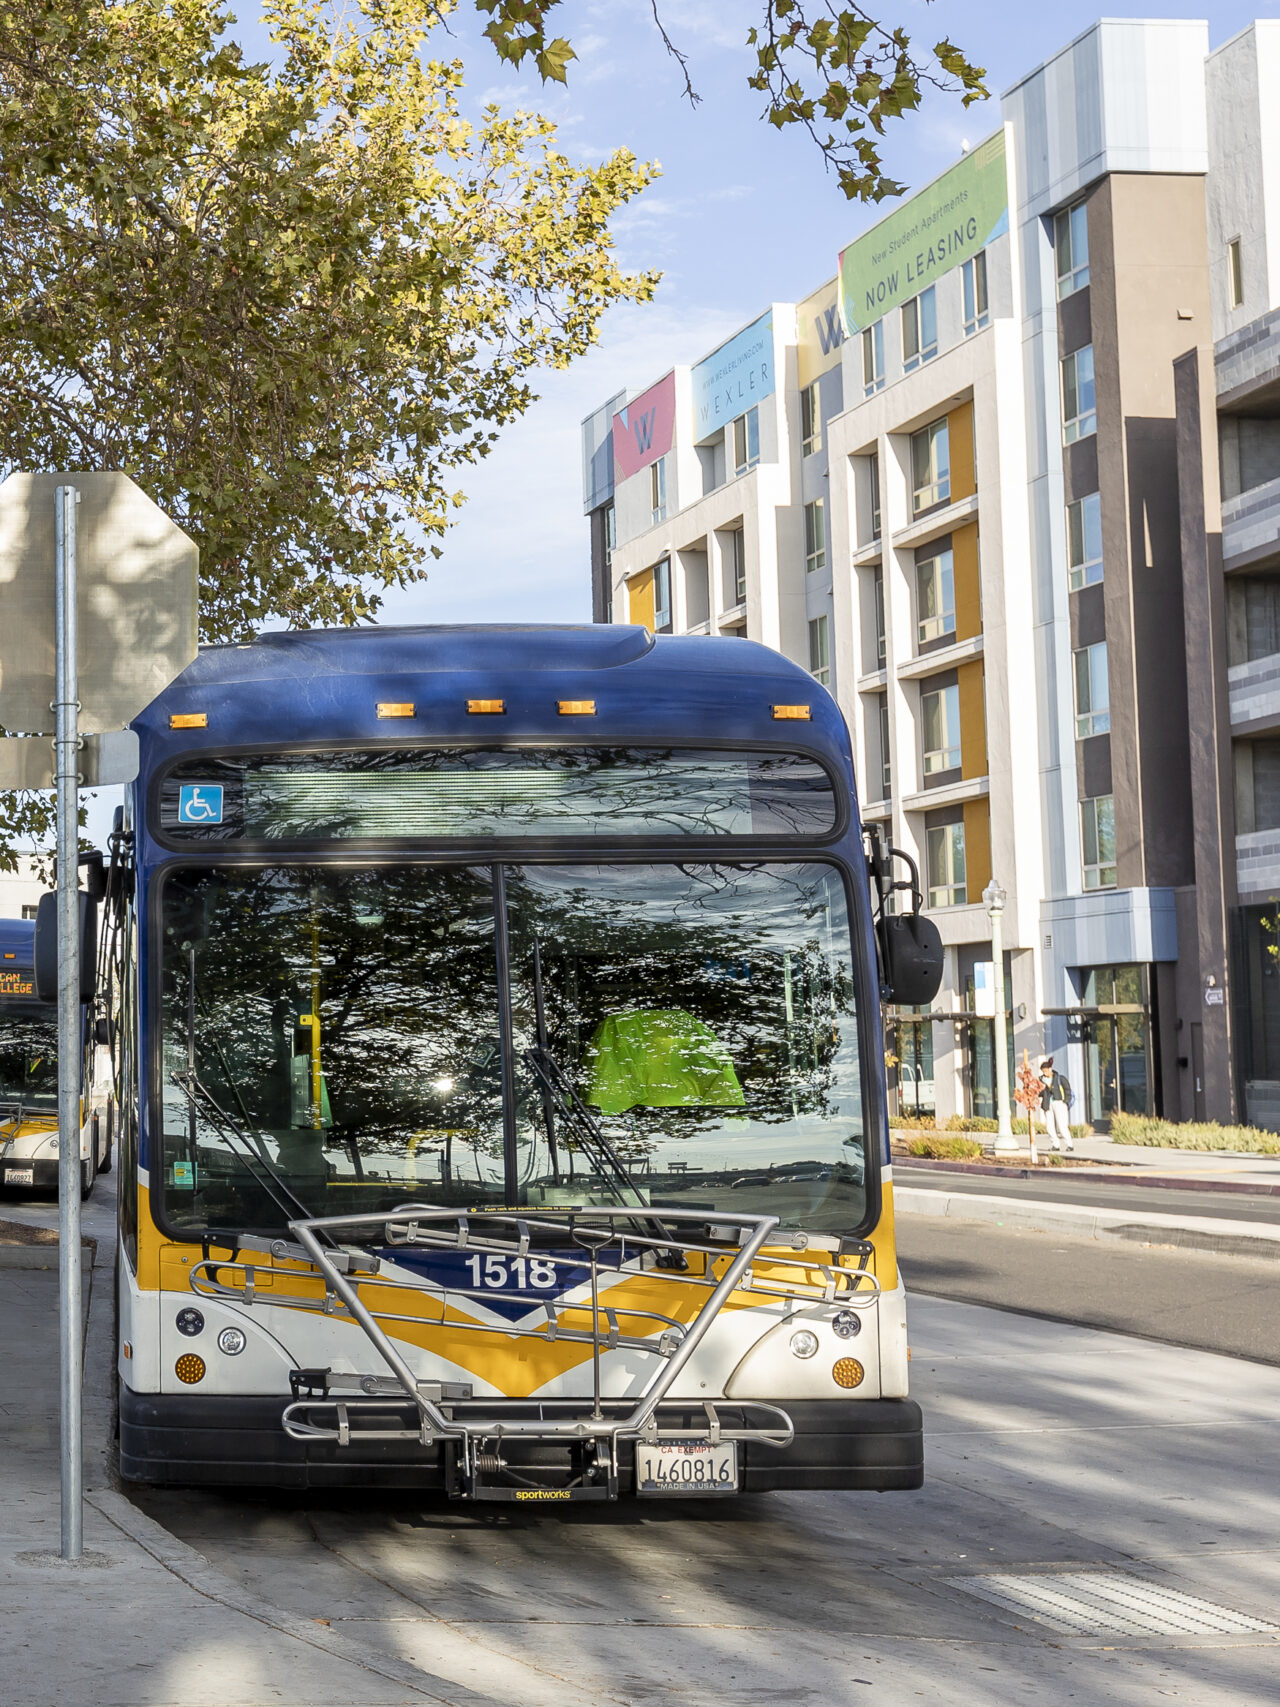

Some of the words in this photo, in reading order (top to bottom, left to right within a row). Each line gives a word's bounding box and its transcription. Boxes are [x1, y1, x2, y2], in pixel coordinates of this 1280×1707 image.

[871, 249, 887, 266] New
[889, 225, 919, 254] Student
[920, 190, 969, 231] Apartments
[866, 269, 899, 311] NOW
[907, 217, 977, 283] LEASING
[701, 363, 768, 421] WEXLER
[634, 406, 656, 455] W
[465, 1254, 557, 1288] 1518
[645, 1459, 730, 1482] 1460816
[661, 1446, 674, 1454] CA
[678, 1446, 712, 1455] EXEMPT
[516, 1490, 571, 1500] sportworks
